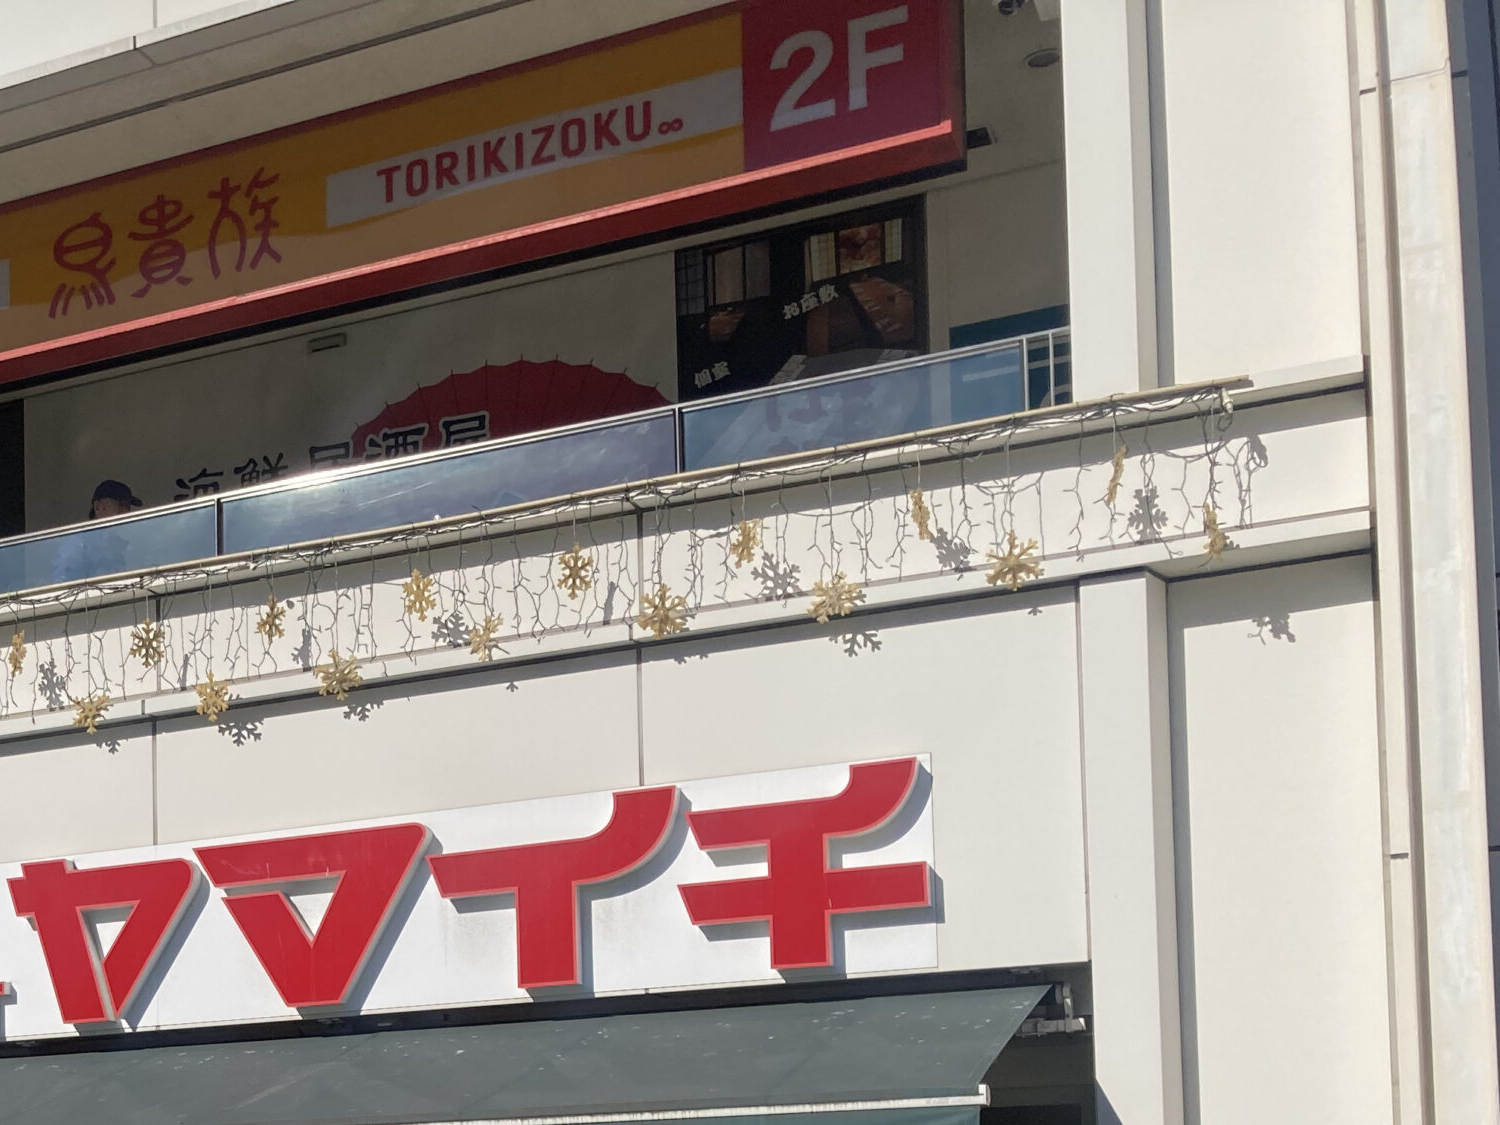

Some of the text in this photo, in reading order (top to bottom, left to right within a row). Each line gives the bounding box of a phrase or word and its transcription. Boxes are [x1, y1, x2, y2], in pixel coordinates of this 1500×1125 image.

[767, 7, 910, 134] 2F
[376, 101, 652, 203] TORIKIZOKU
[7, 757, 932, 1025] ヤマイチ
